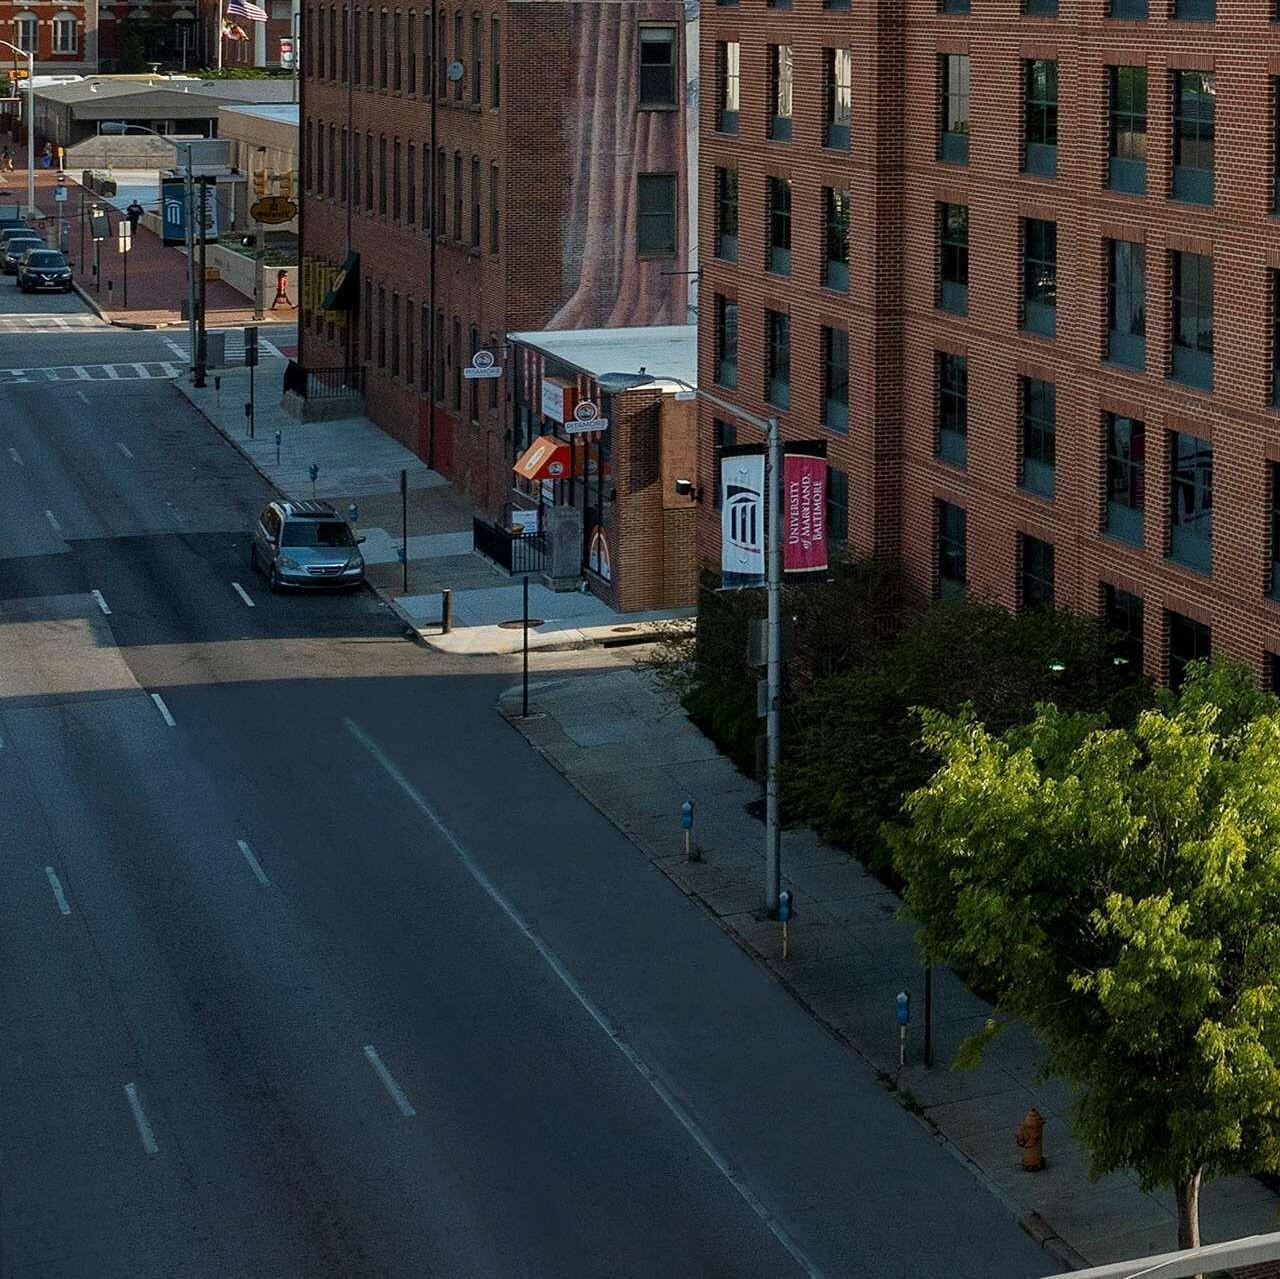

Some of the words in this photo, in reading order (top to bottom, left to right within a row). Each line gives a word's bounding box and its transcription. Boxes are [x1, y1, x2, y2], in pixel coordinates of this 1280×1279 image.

[789, 480, 800, 545] UNIVERSITY
[812, 480, 823, 541] BALTIMORE
[802, 538, 812, 550] of
